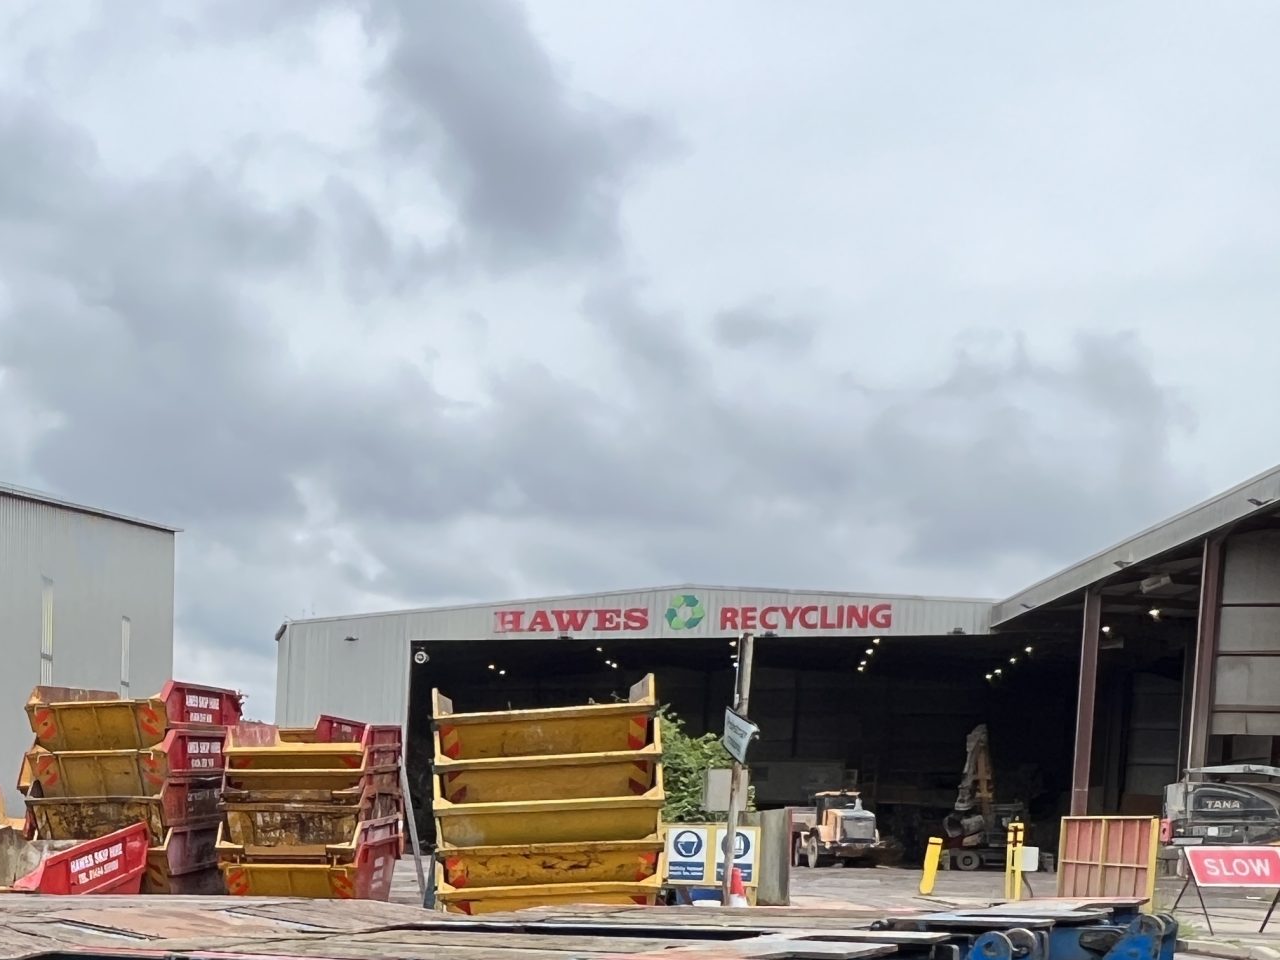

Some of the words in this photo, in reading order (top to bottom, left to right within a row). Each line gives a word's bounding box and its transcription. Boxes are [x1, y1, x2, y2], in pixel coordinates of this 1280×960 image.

[493, 608, 649, 634] HAWES
[719, 603, 892, 631] RECYCLING
[1206, 800, 1241, 809] TANA
[1203, 858, 1271, 876] SLOW
